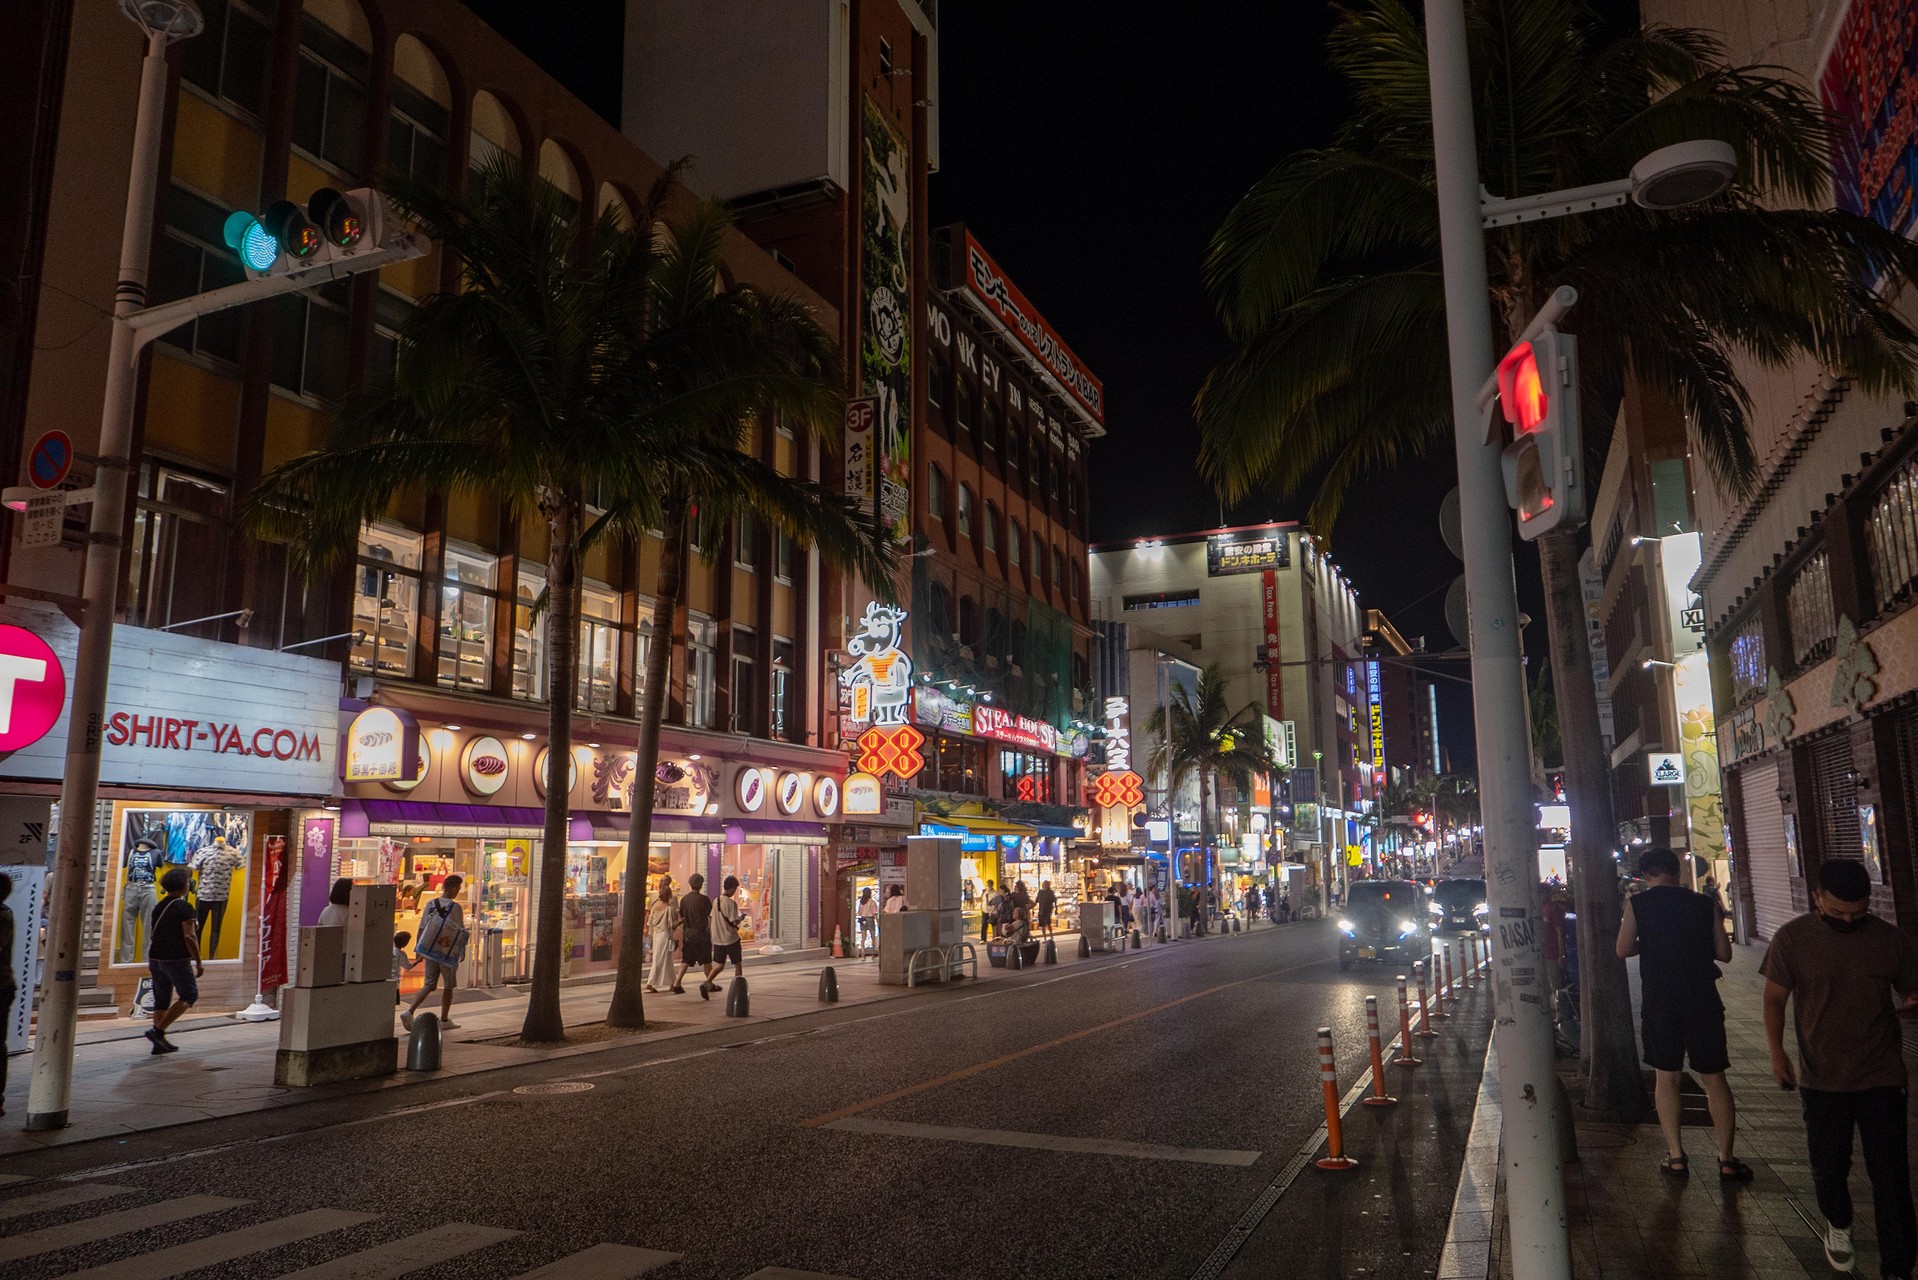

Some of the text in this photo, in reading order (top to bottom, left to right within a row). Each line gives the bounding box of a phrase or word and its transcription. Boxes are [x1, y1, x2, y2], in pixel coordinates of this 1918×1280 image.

[847, 408, 872, 428] 3F
[1266, 585, 1274, 600] Tax
[1020, 717, 1056, 749] HOUSE
[857, 726, 924, 779] 88
[1654, 770, 1680, 778] XLARGE
[1095, 772, 1142, 808] 88
[19, 834, 33, 844] 2F
